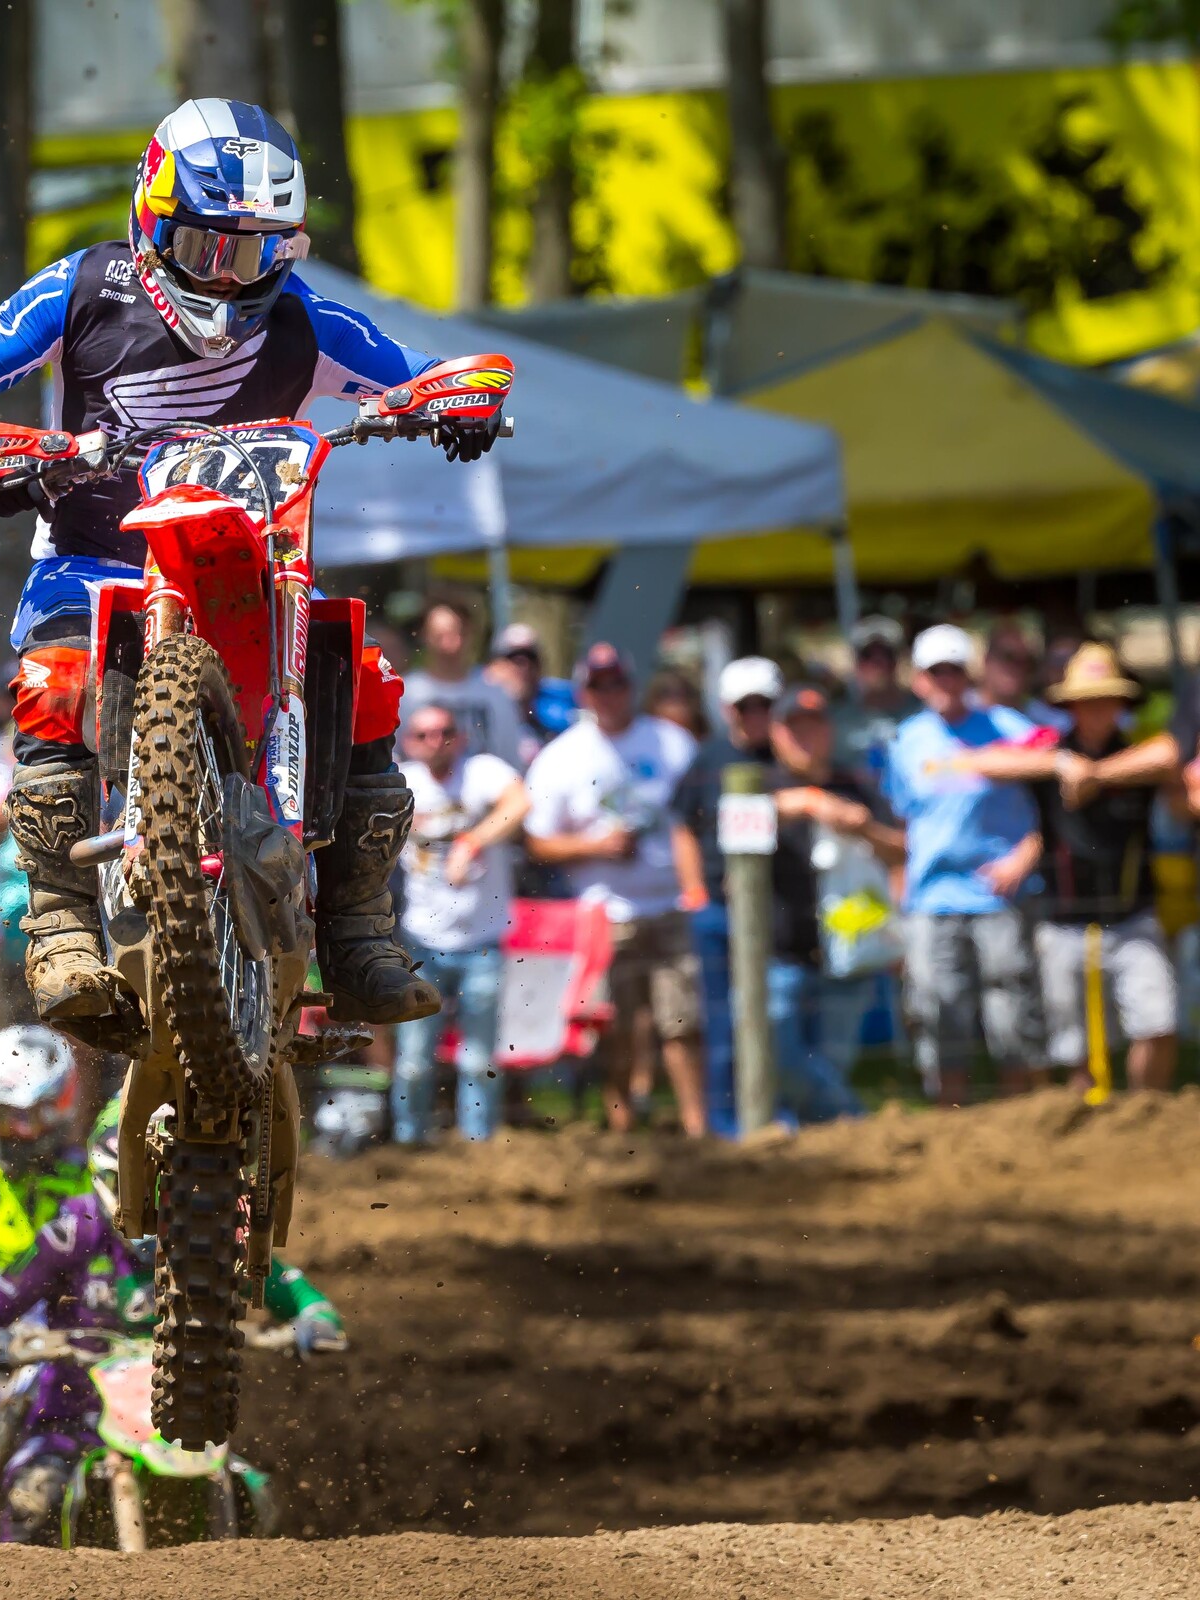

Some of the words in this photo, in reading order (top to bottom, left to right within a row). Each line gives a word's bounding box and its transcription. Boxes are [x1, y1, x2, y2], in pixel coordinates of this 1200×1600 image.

[99, 288, 137, 304] SHOWA
[427, 393, 489, 412] CYCRA
[235, 430, 261, 443] OIL
[288, 712, 300, 796] DUNLOP
